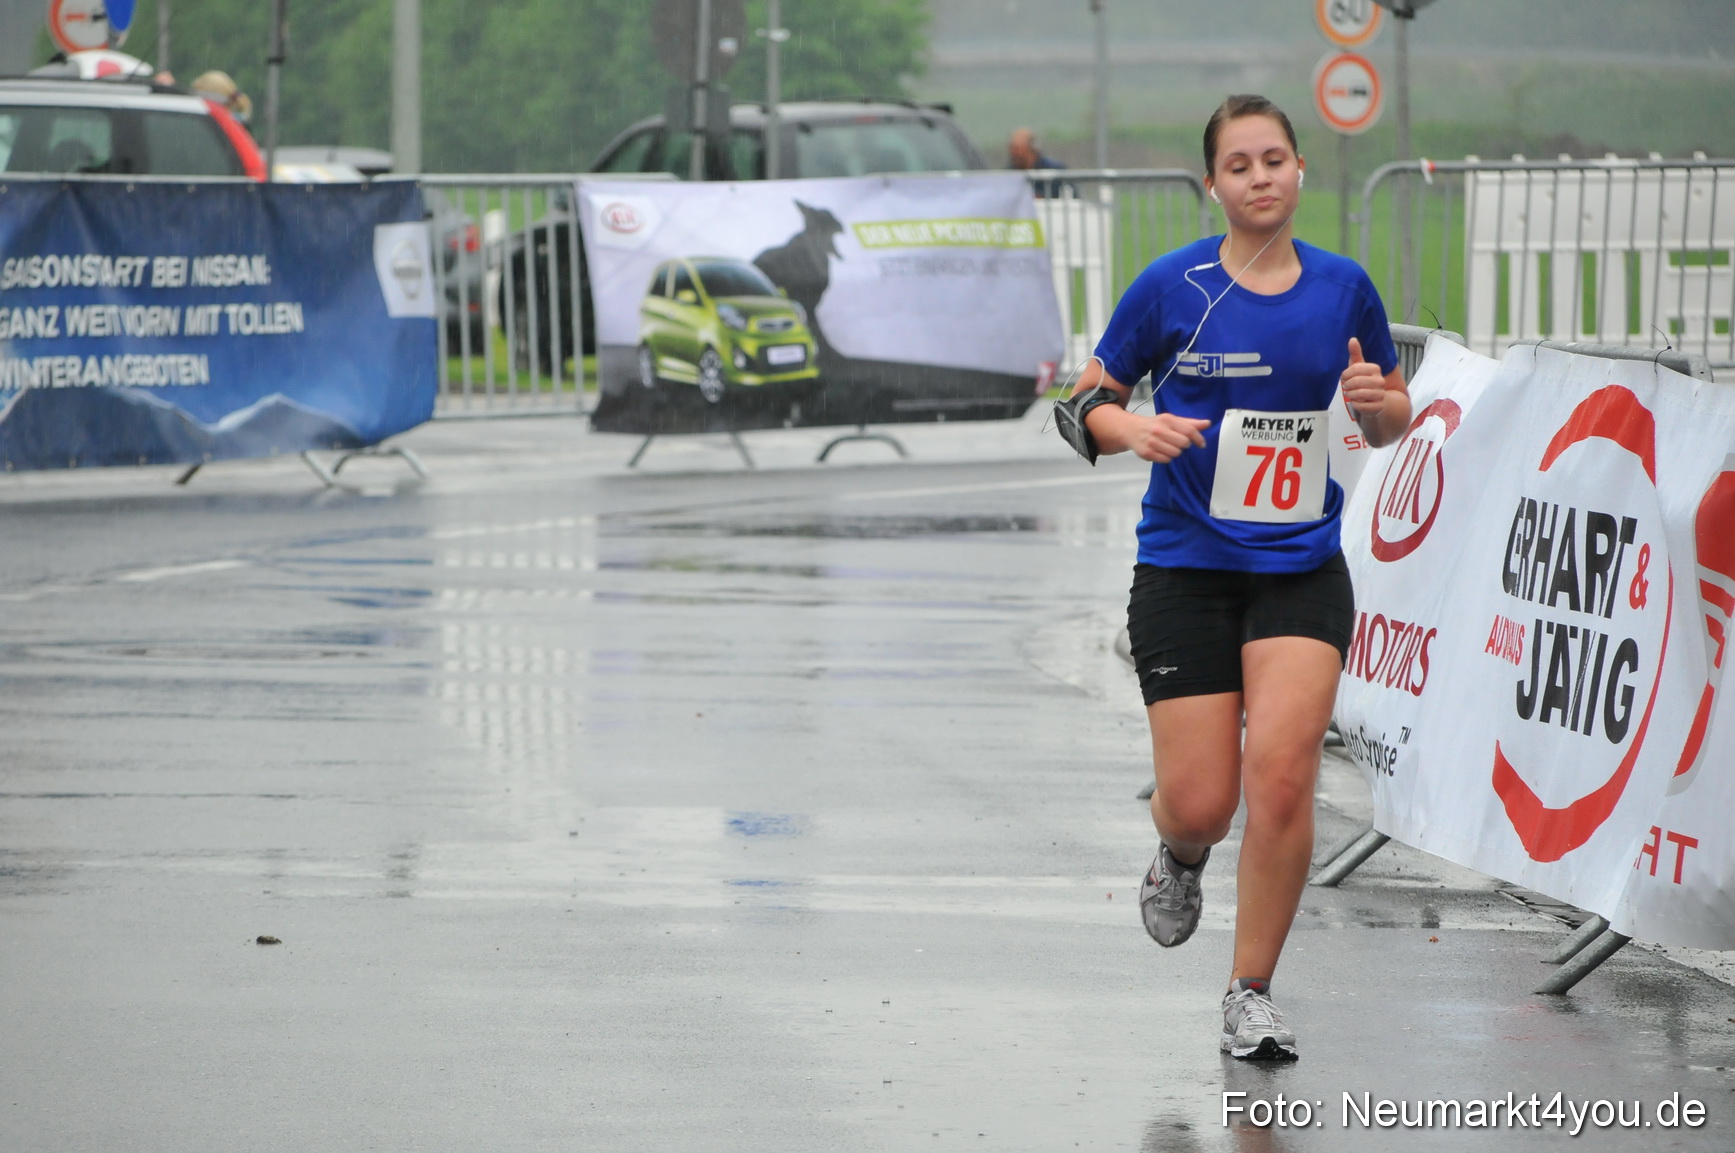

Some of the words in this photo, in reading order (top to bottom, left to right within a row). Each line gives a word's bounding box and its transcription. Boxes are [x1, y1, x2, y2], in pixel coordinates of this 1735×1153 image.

[151, 255, 188, 288] BEI
[190, 253, 271, 287] NISSAN:
[0, 304, 60, 340] GANZ
[184, 303, 222, 336] MIT
[223, 301, 304, 336] TOLLEN
[1241, 429, 1294, 442] WERBUNG
[1242, 416, 1295, 431] MEYER
[1243, 445, 1303, 511] 76
[1628, 542, 1651, 611] &
[1345, 609, 1438, 697] MOTORS
